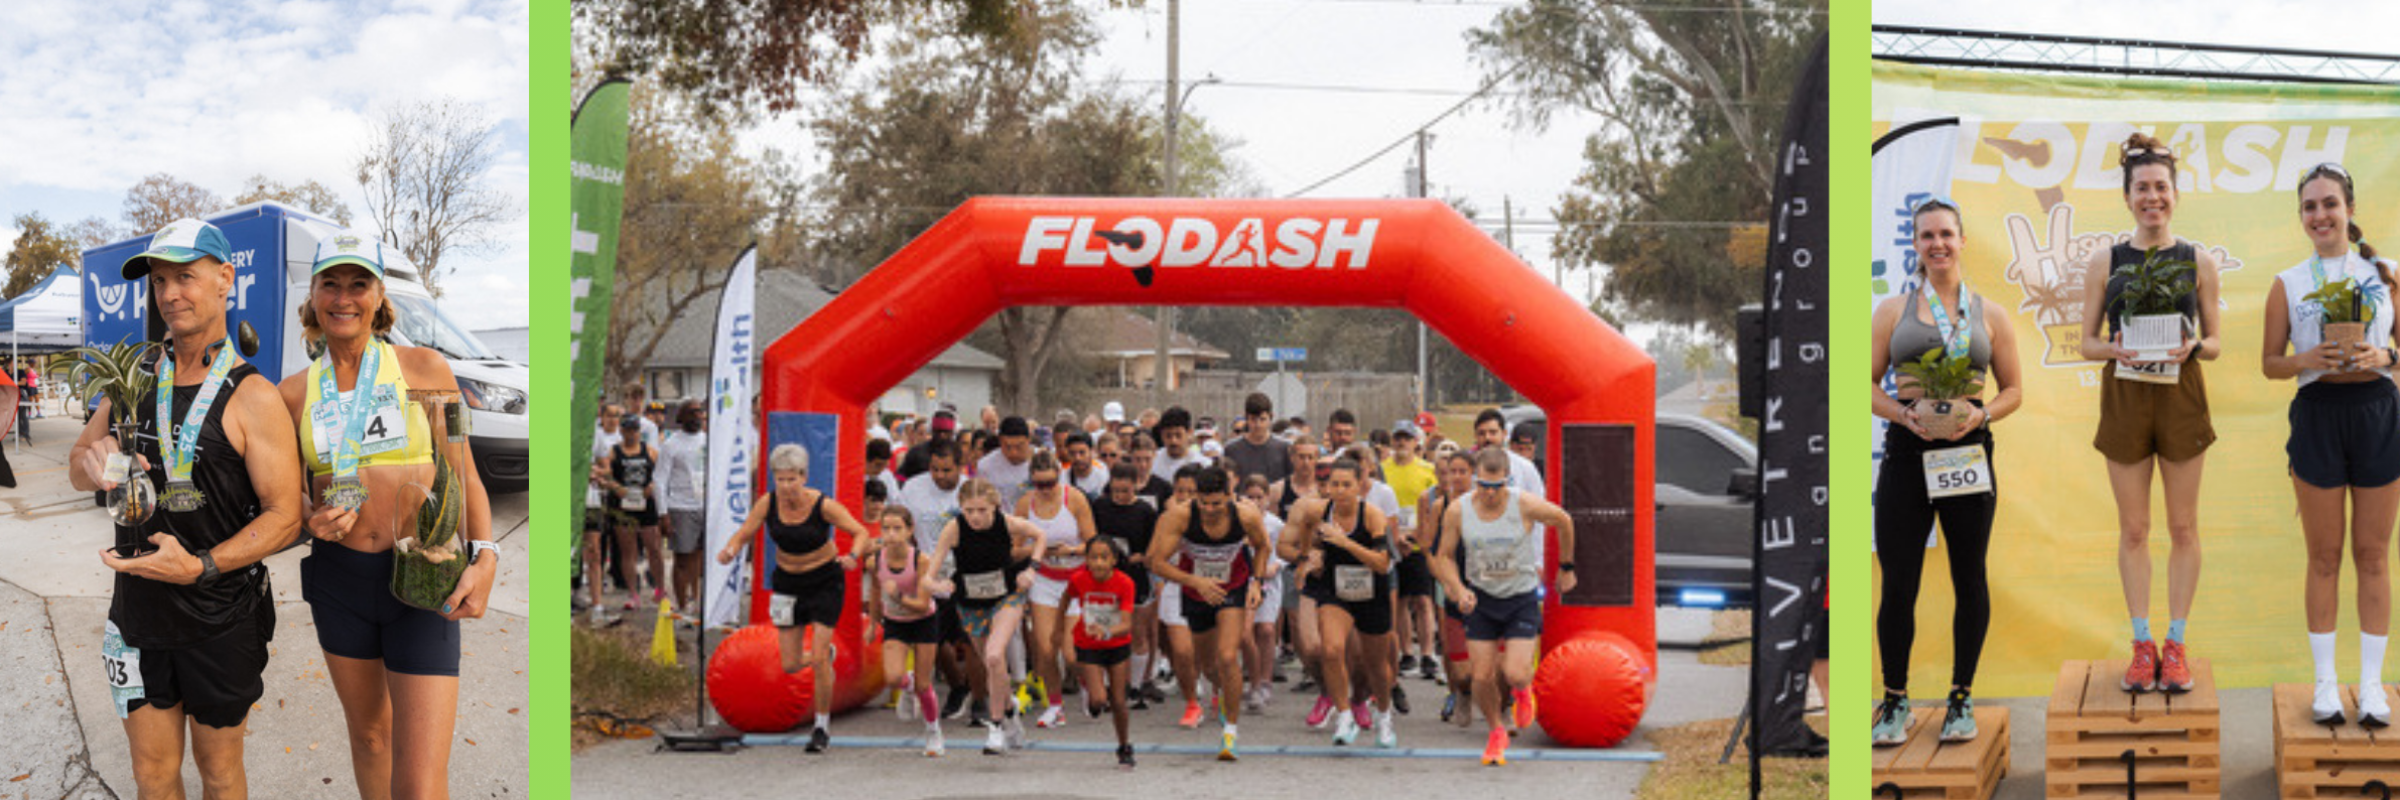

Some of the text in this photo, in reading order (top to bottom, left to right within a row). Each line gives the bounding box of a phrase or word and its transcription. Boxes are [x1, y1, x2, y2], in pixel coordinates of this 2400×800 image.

[1893, 108, 2350, 195] LODASH
[1018, 216, 1380, 269] FLODASH
[231, 249, 255, 268] ERY
[2060, 344, 2082, 355] TH
[322, 379, 336, 400] '25
[179, 374, 224, 453] HILLS '25
[1938, 469, 1977, 489] 550
[102, 655, 129, 687] 03
